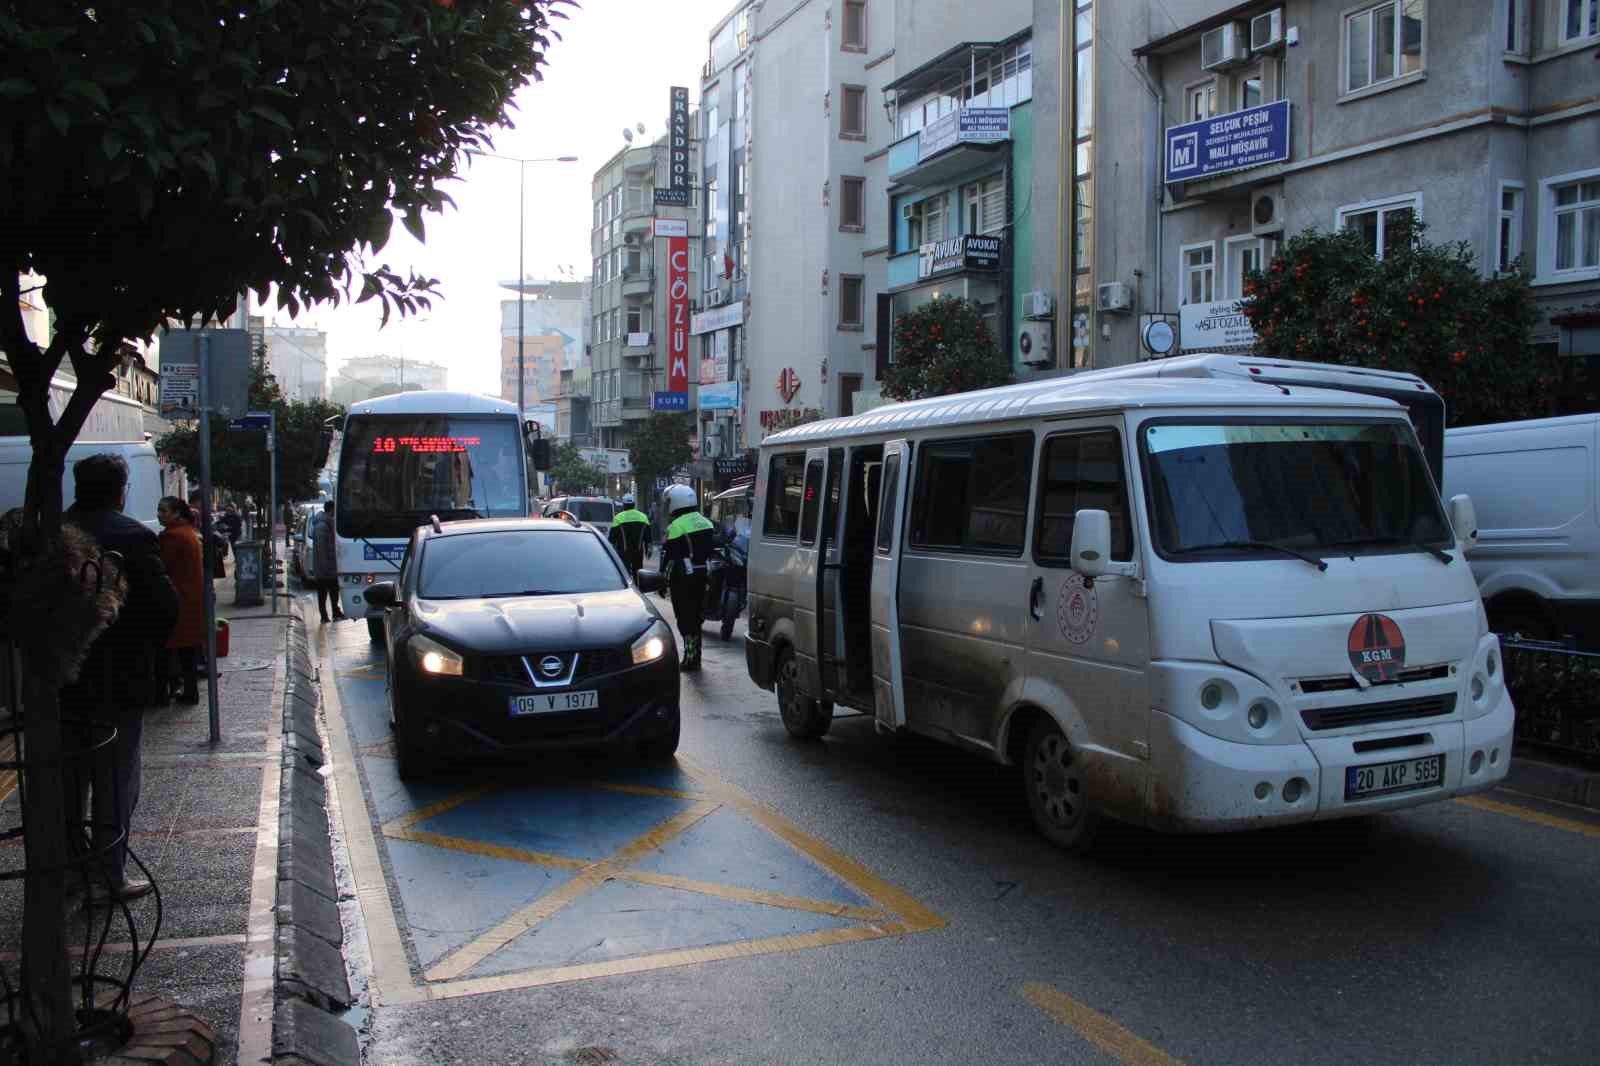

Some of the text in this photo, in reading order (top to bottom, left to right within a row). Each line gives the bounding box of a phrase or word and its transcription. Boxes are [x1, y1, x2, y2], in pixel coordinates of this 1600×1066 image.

[1209, 110, 1269, 135] SELÇUK PEŞİN
[674, 89, 685, 186] GRAND DOR
[1209, 144, 1229, 160] MALİ
[1231, 136, 1268, 155] MÜŞAVİR
[934, 237, 964, 260] AVUKAT
[967, 238, 998, 250] AVUKAT
[373, 437, 396, 452] 10
[1361, 648, 1393, 663] KGM
[519, 692, 595, 713] 09 V 1977
[1357, 759, 1438, 790] 20 AKP 565
